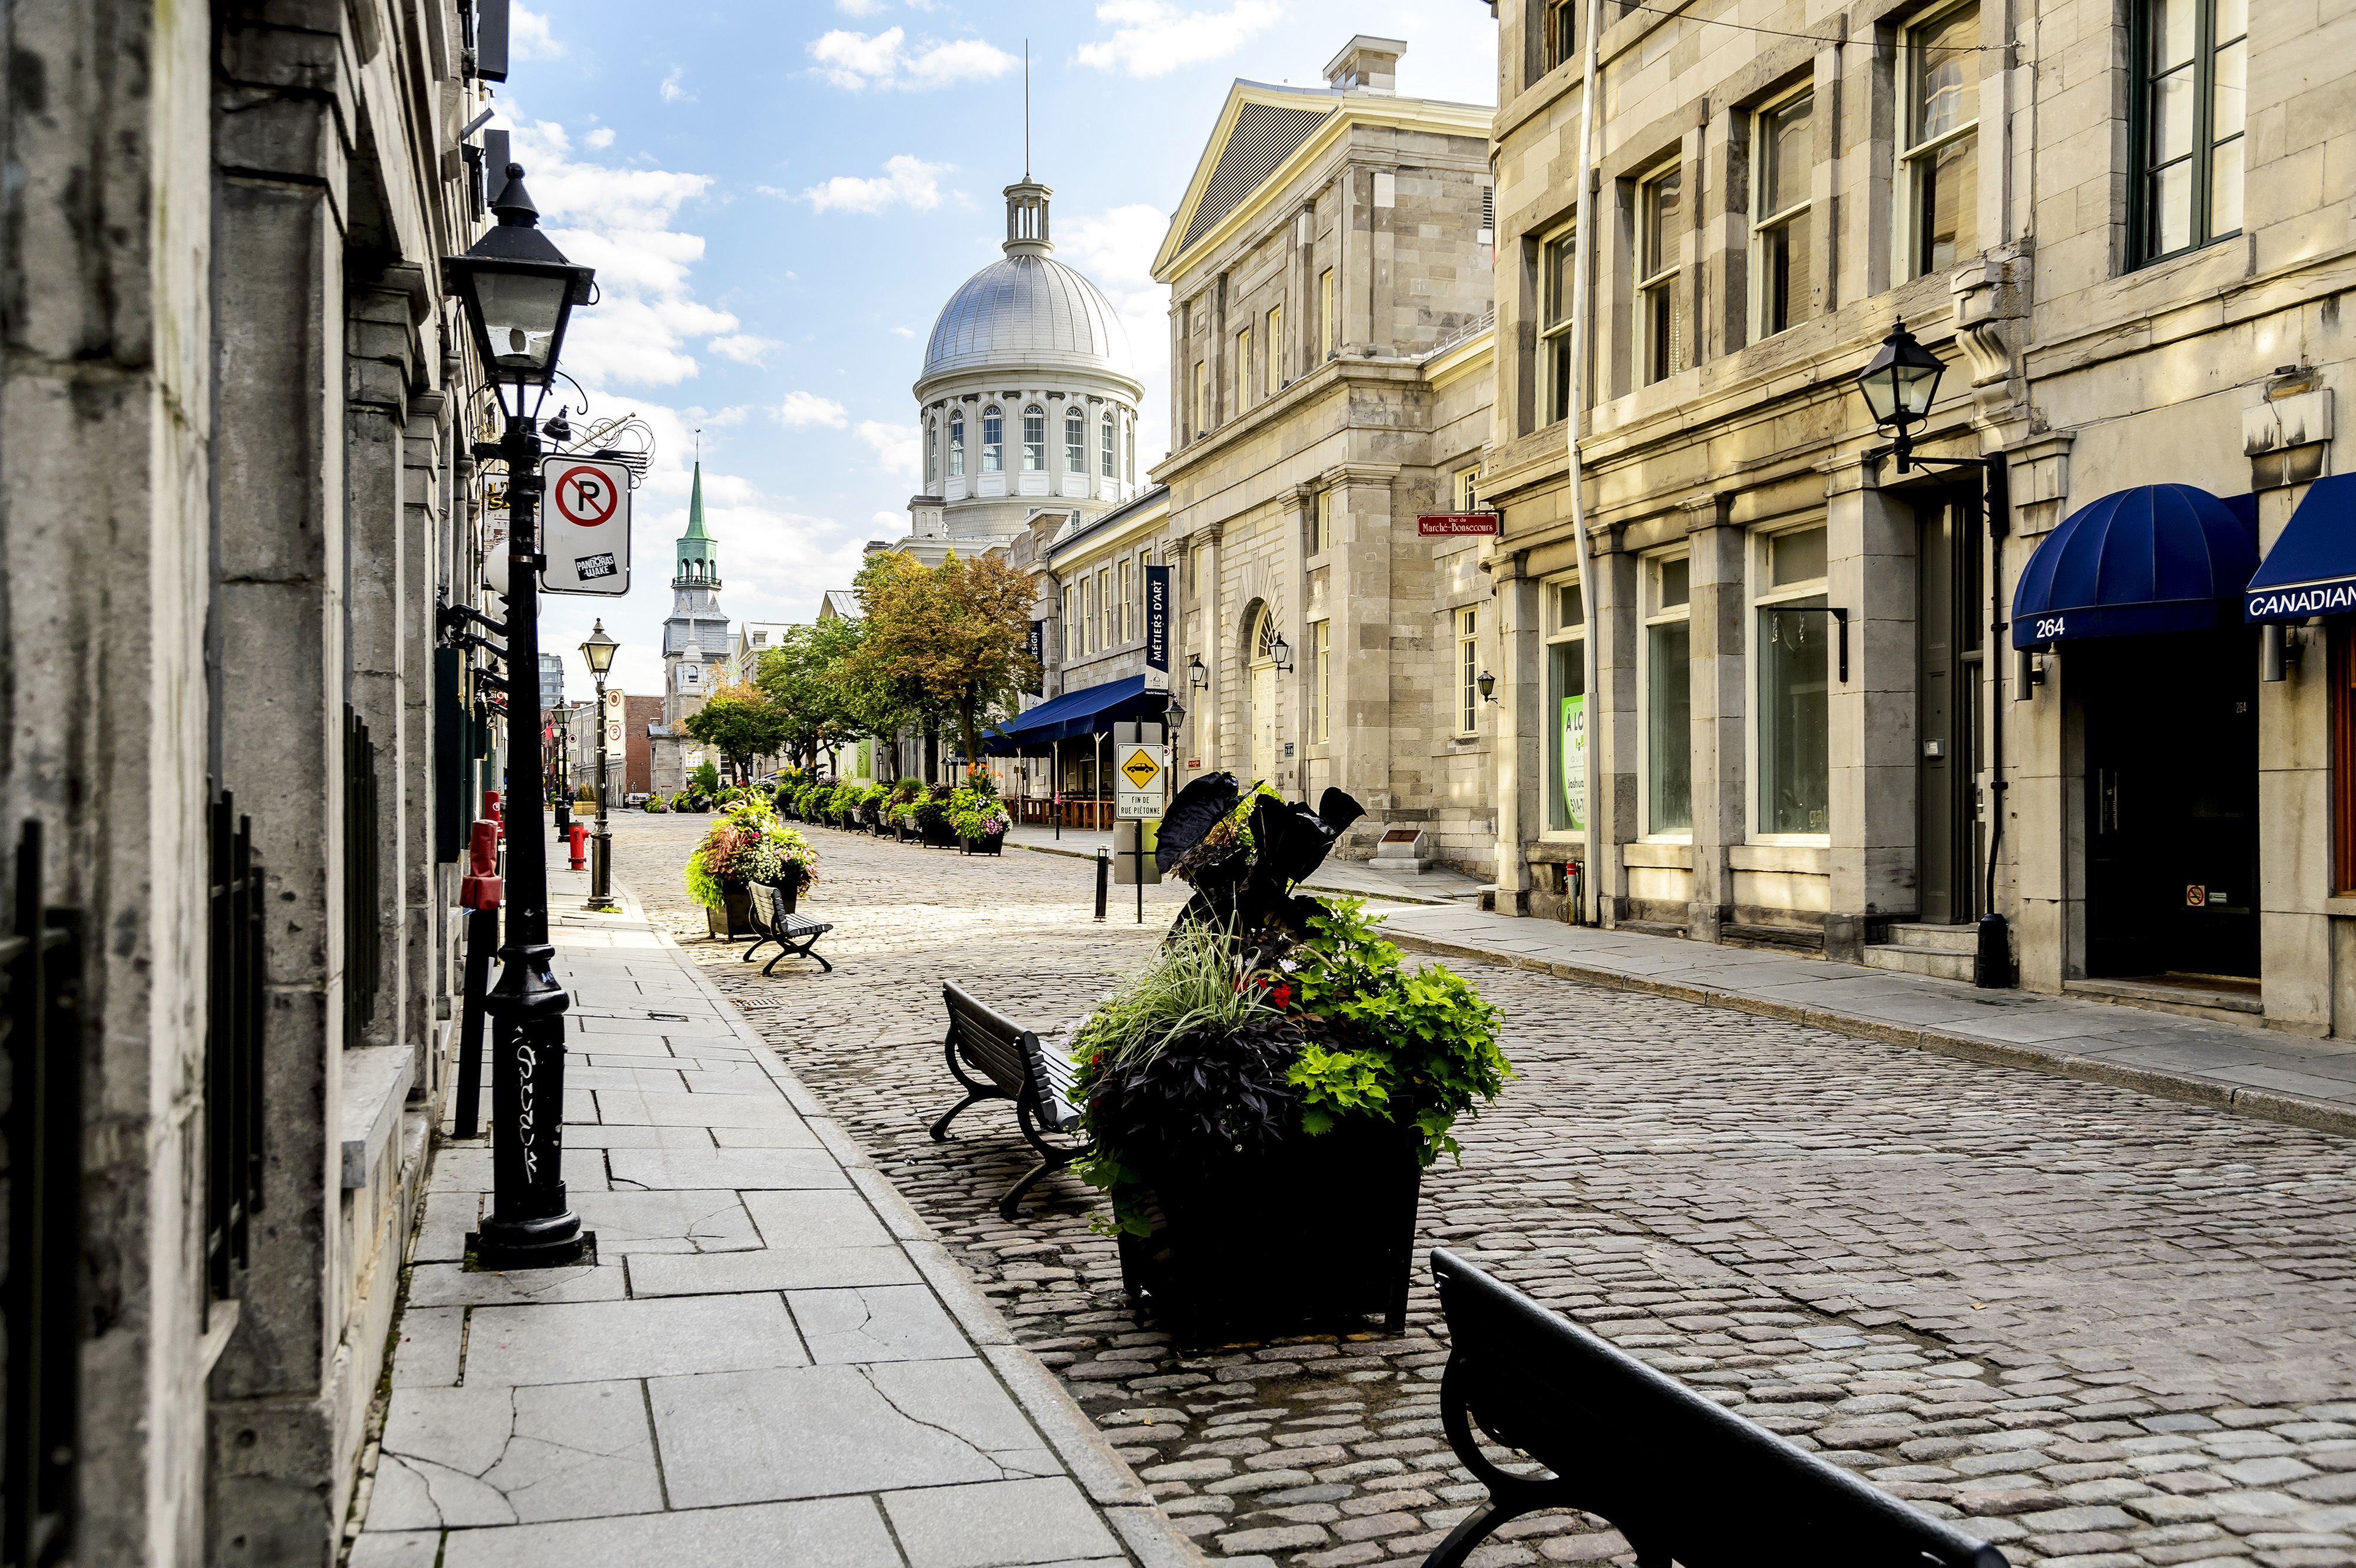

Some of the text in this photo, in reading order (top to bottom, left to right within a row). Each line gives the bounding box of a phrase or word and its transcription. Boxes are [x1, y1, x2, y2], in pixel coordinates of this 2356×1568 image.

[1422, 522, 1493, 532] Marché-Bonsecours
[584, 565, 610, 577] WAKE
[1151, 580, 1162, 661] MÉTIERS D'ART
[2036, 617, 2065, 639] 264
[1566, 707, 1571, 732] À
